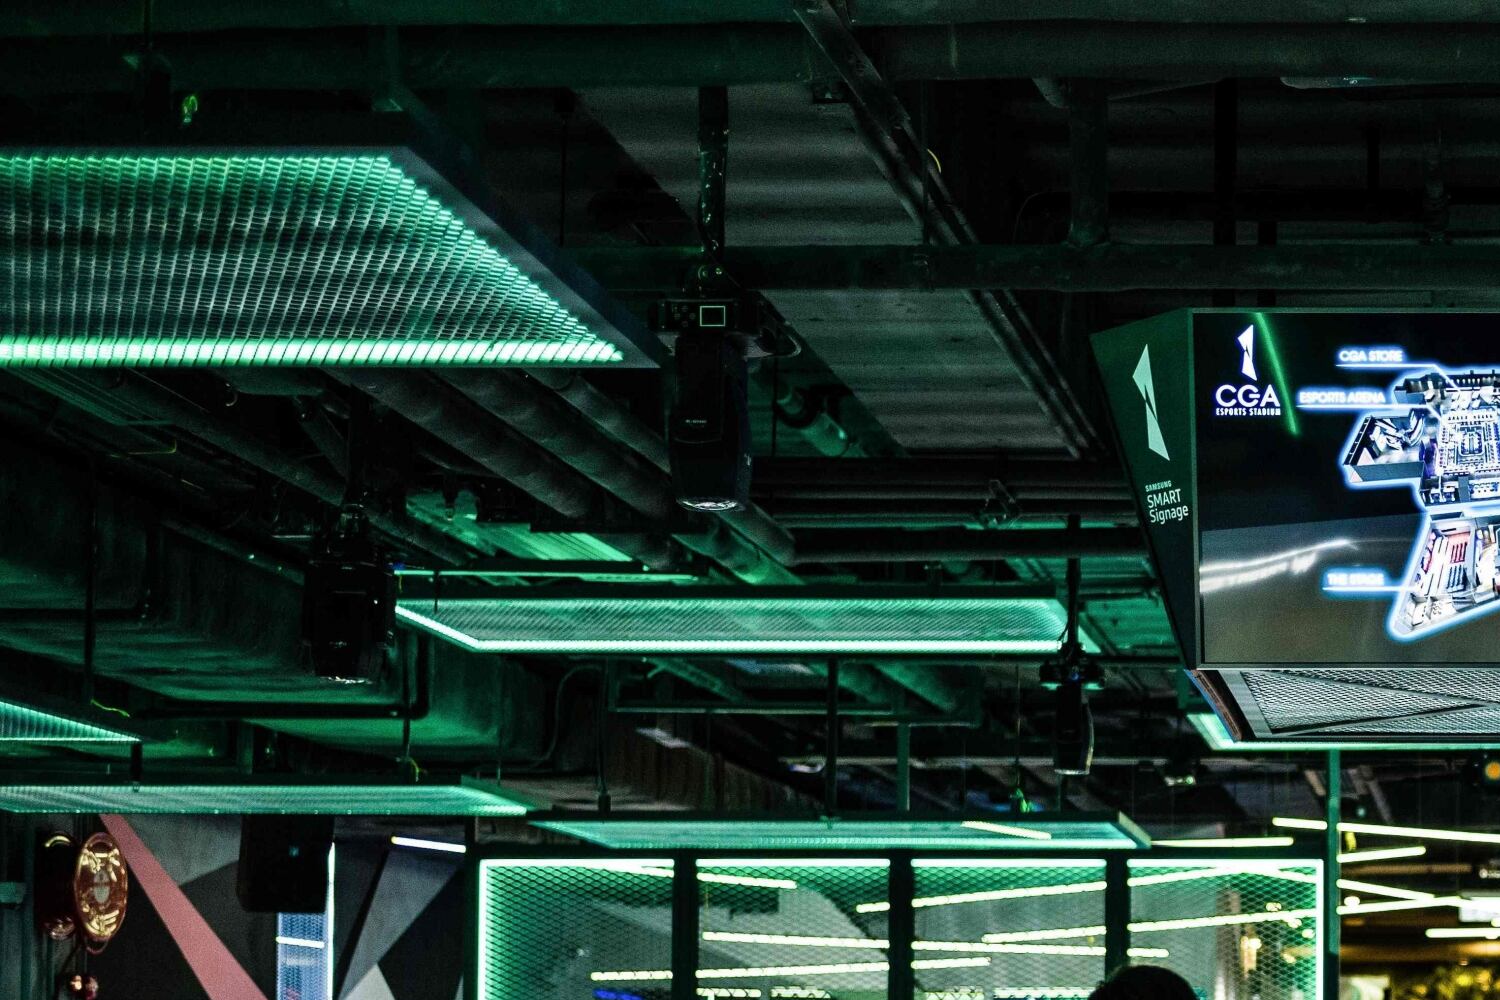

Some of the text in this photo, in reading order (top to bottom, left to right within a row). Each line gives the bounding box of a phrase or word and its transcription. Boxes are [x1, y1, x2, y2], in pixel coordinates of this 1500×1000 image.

[1339, 351, 1403, 362] CGA STORE
[1215, 384, 1281, 407] CGA
[1300, 392, 1386, 403] ESPORTS ARENA
[1216, 408, 1281, 416] ESPORTS STADIUM
[1145, 480, 1172, 492] SAMSUNG
[1147, 489, 1181, 508] SMART
[1149, 505, 1189, 525] Signage
